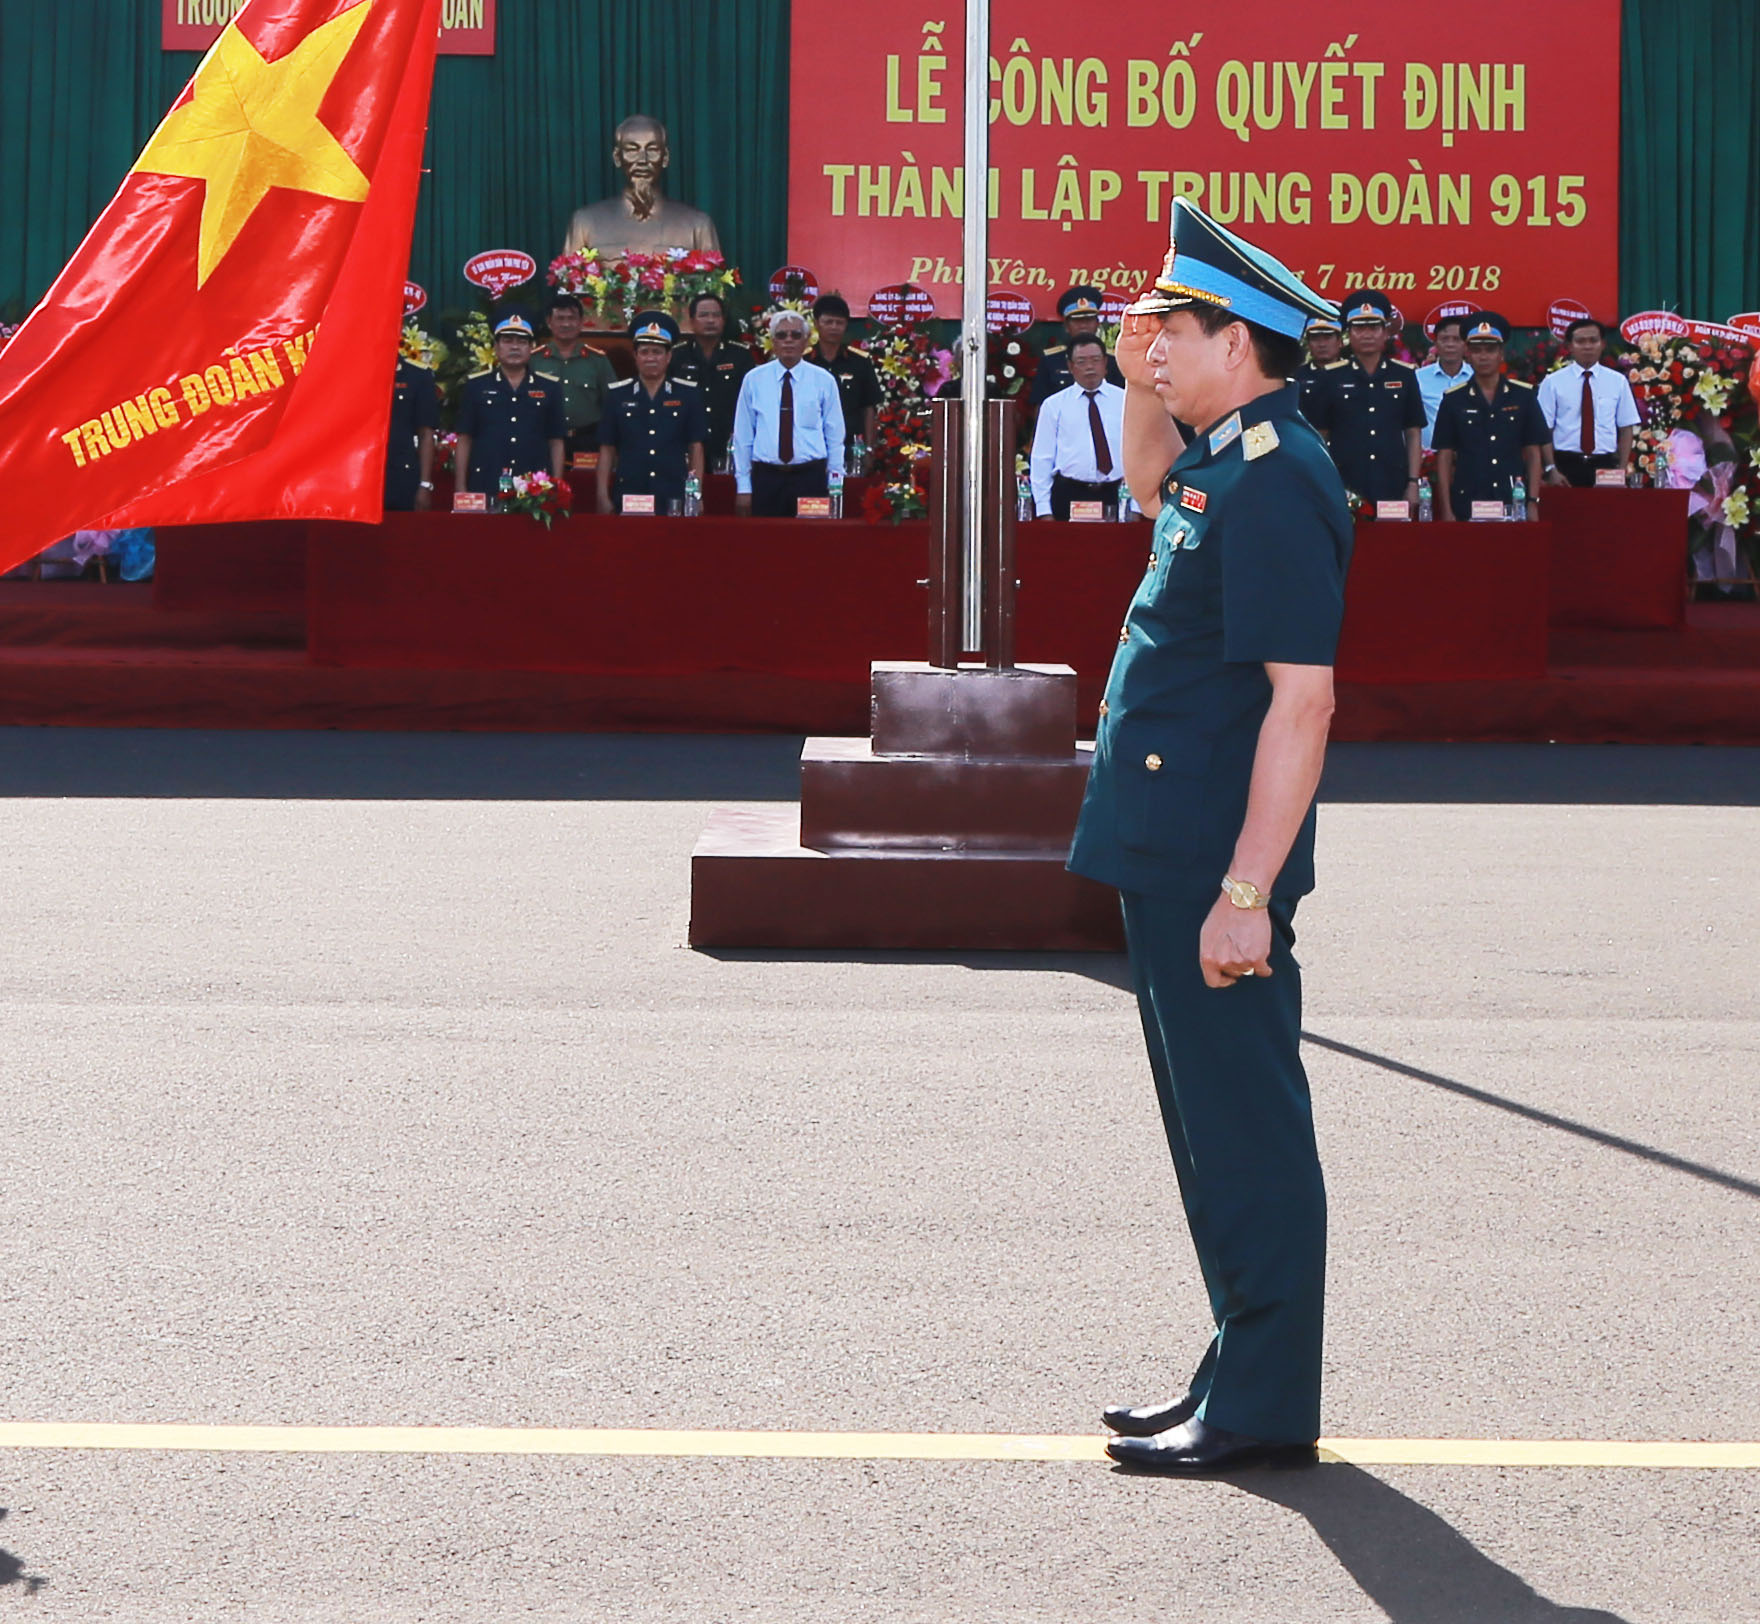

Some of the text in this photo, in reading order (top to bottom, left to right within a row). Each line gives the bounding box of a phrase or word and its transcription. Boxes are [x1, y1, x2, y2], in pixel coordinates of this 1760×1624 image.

[886, 20, 948, 123] LỄ
[1127, 32, 1203, 129] BỐ
[1216, 34, 1385, 141] QUYẾT
[1403, 62, 1525, 147] ĐỊNH
[1021, 155, 1122, 232] LẬP
[1137, 170, 1312, 225] TRUNG
[1329, 158, 1471, 226] ĐOÀN
[1490, 173, 1587, 227] 915
[987, 257, 1056, 292] Yên,
[1069, 262, 1148, 294] ngày
[1344, 265, 1417, 290] năm
[1426, 265, 1502, 291] 2018
[61, 387, 180, 468] TRUNG
[179, 347, 285, 416] ĐOÀN
